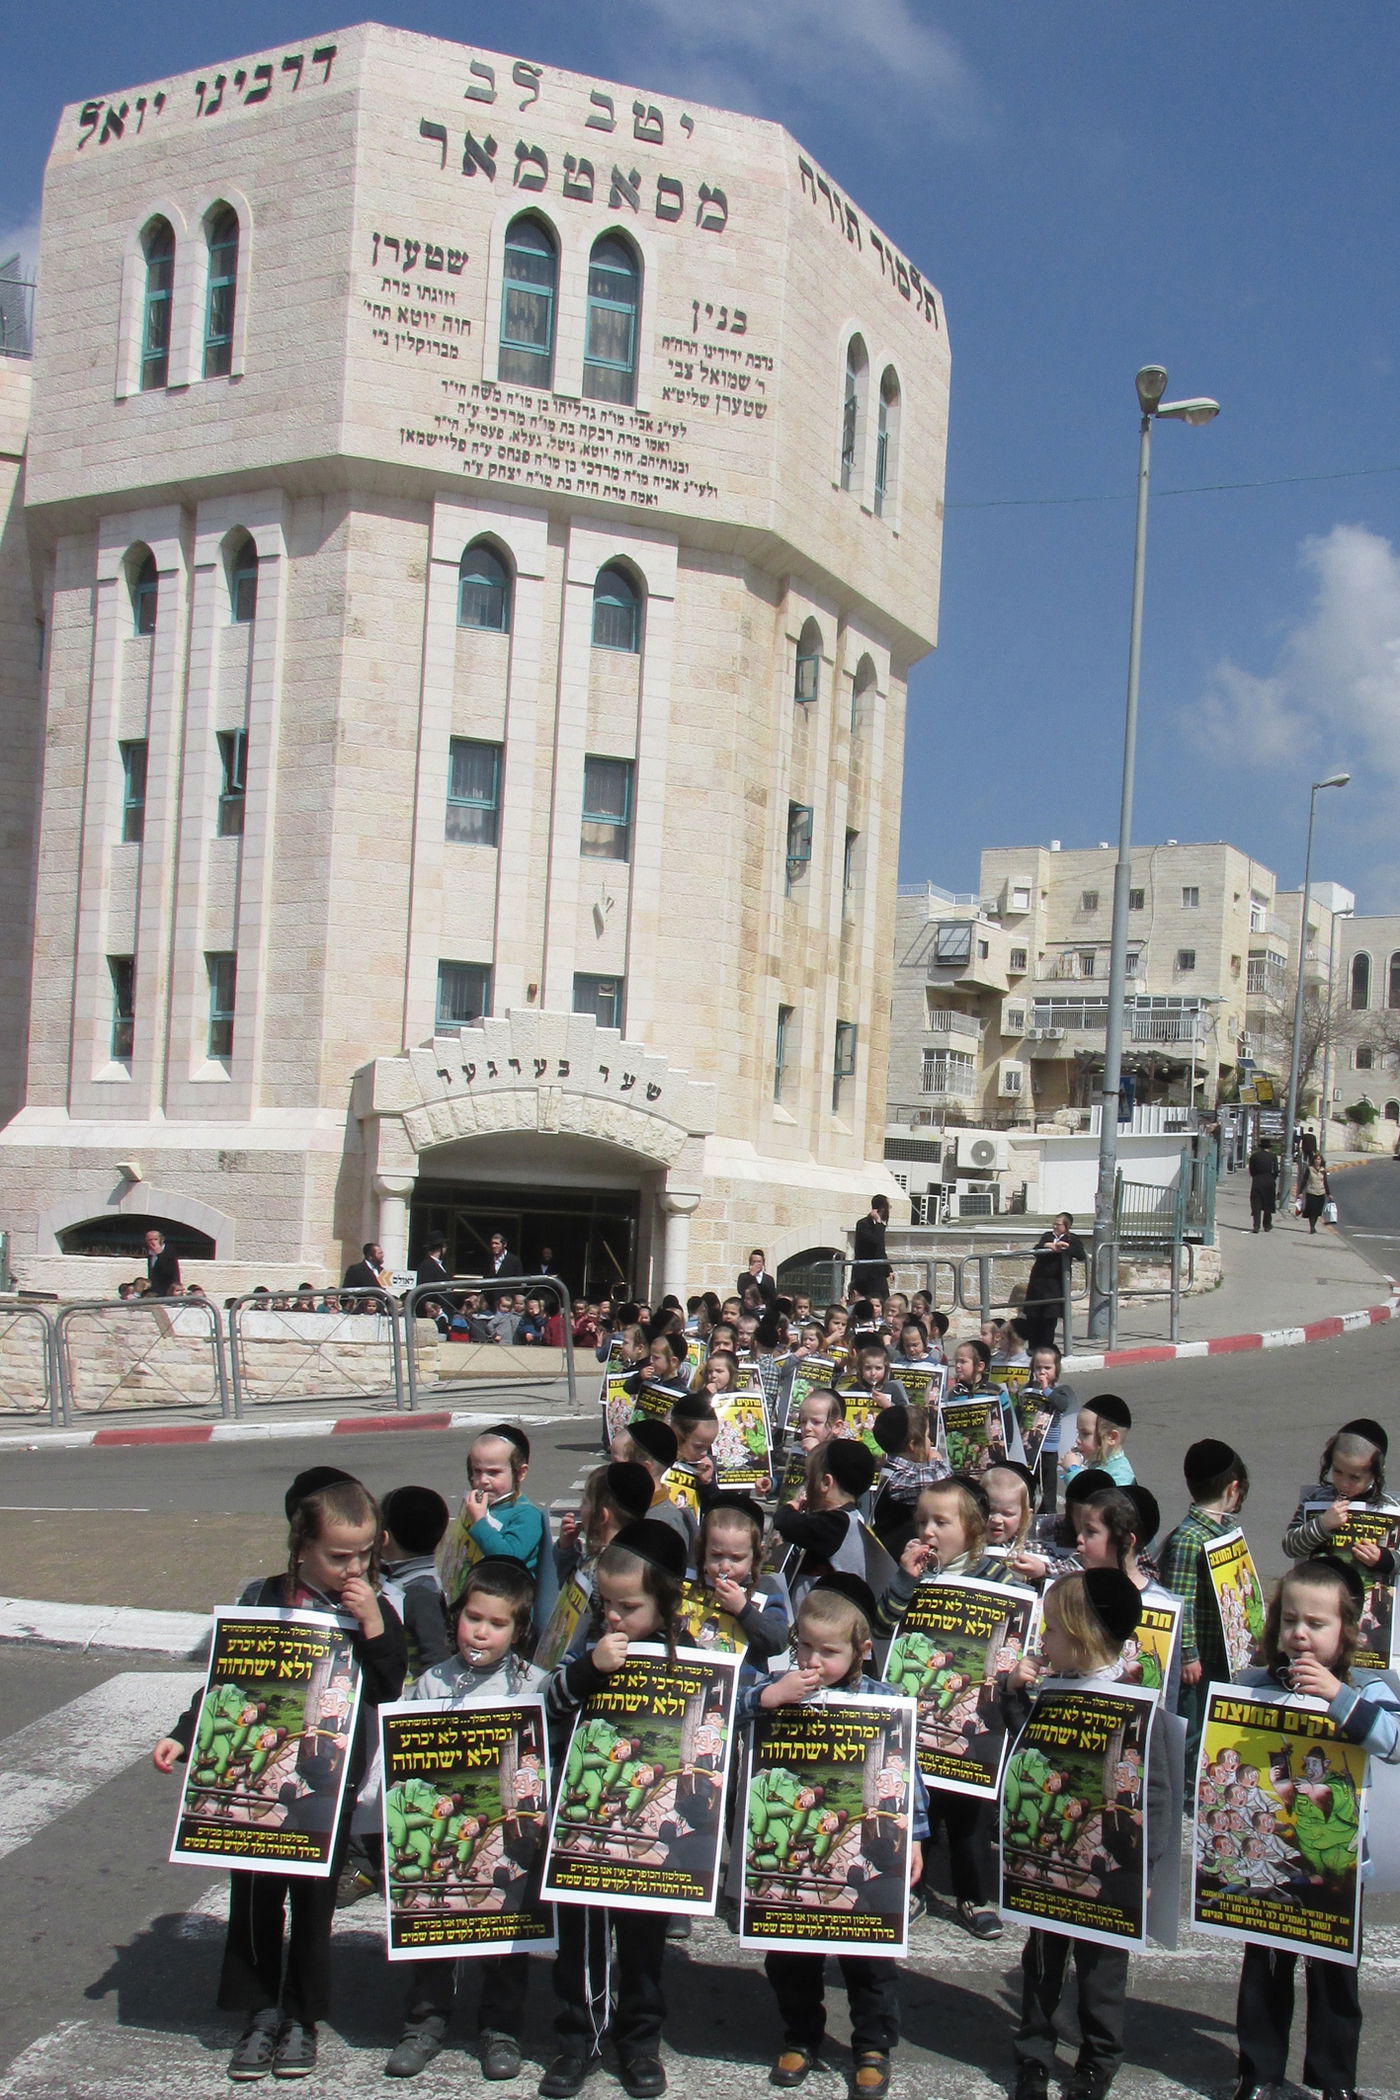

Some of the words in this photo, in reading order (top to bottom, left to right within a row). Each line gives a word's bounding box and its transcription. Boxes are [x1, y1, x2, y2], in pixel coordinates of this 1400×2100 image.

[195, 45, 338, 118] דרבינו
[463, 58, 543, 112] לב
[77, 91, 166, 150] יואל
[585, 89, 695, 146] יטב
[419, 117, 729, 233] מסאטמאר
[799, 155, 862, 252] תורה
[372, 231, 469, 275] שטערן
[381, 277, 410, 296] מרת
[870, 229, 938, 331] תלמוד
[417, 284, 455, 305] וזוגתו
[398, 305, 436, 328] יוטא
[442, 315, 471, 336] חוה
[692, 299, 747, 335] בנין
[395, 331, 458, 359] מברוקלין
[703, 344, 742, 362] ידידינו
[668, 359, 694, 380] צבי
[746, 352, 774, 371] נדבת
[700, 360, 751, 391] שמואל
[716, 394, 767, 419] שטערן
[436, 1058, 570, 1085] בערגער
[599, 1064, 662, 1101] שער
[916, 1598, 942, 1608] יכרע
[944, 1599, 962, 1612] לא
[965, 1603, 1006, 1621] ומרדכי
[905, 1612, 962, 1630] ישתחוה
[964, 1616, 992, 1638] ולא
[227, 1639, 255, 1652] יכרע
[257, 1636, 276, 1652] לא
[279, 1641, 330, 1657] ומרדכי
[216, 1658, 276, 1676] ישתחוה
[279, 1655, 313, 1680] ולא
[627, 1671, 648, 1687] לא
[652, 1692, 686, 1716] ולא
[1062, 1705, 1079, 1721] לא
[1082, 1711, 1122, 1729] ומרדכי
[1213, 1700, 1280, 1728] החוצה
[438, 1727, 458, 1745] לא
[462, 1728, 513, 1743] ומרדכי
[806, 1719, 826, 1736] לא
[830, 1723, 880, 1739] ומרדכי
[1024, 1723, 1077, 1745] ישתחוה
[400, 1732, 434, 1748] יכרע
[1079, 1726, 1107, 1752] ולא
[466, 1742, 499, 1767] ולא
[760, 1742, 828, 1759] ישתחוה
[833, 1737, 865, 1761] ולא
[392, 1750, 462, 1771] ישתחוה
[556, 1874, 582, 1885] שמים
[584, 1876, 600, 1887] שם
[602, 1877, 629, 1892] לקדש
[632, 1878, 648, 1892] נלך
[649, 1882, 679, 1894] התורה
[681, 1885, 704, 1896] בדרך
[752, 1922, 778, 1932] שמים
[780, 1924, 794, 1933] שם
[796, 1923, 822, 1936] לקדש
[824, 1922, 839, 1937] נלך
[841, 1927, 870, 1938] התורה
[872, 1928, 895, 1939] בדרך
